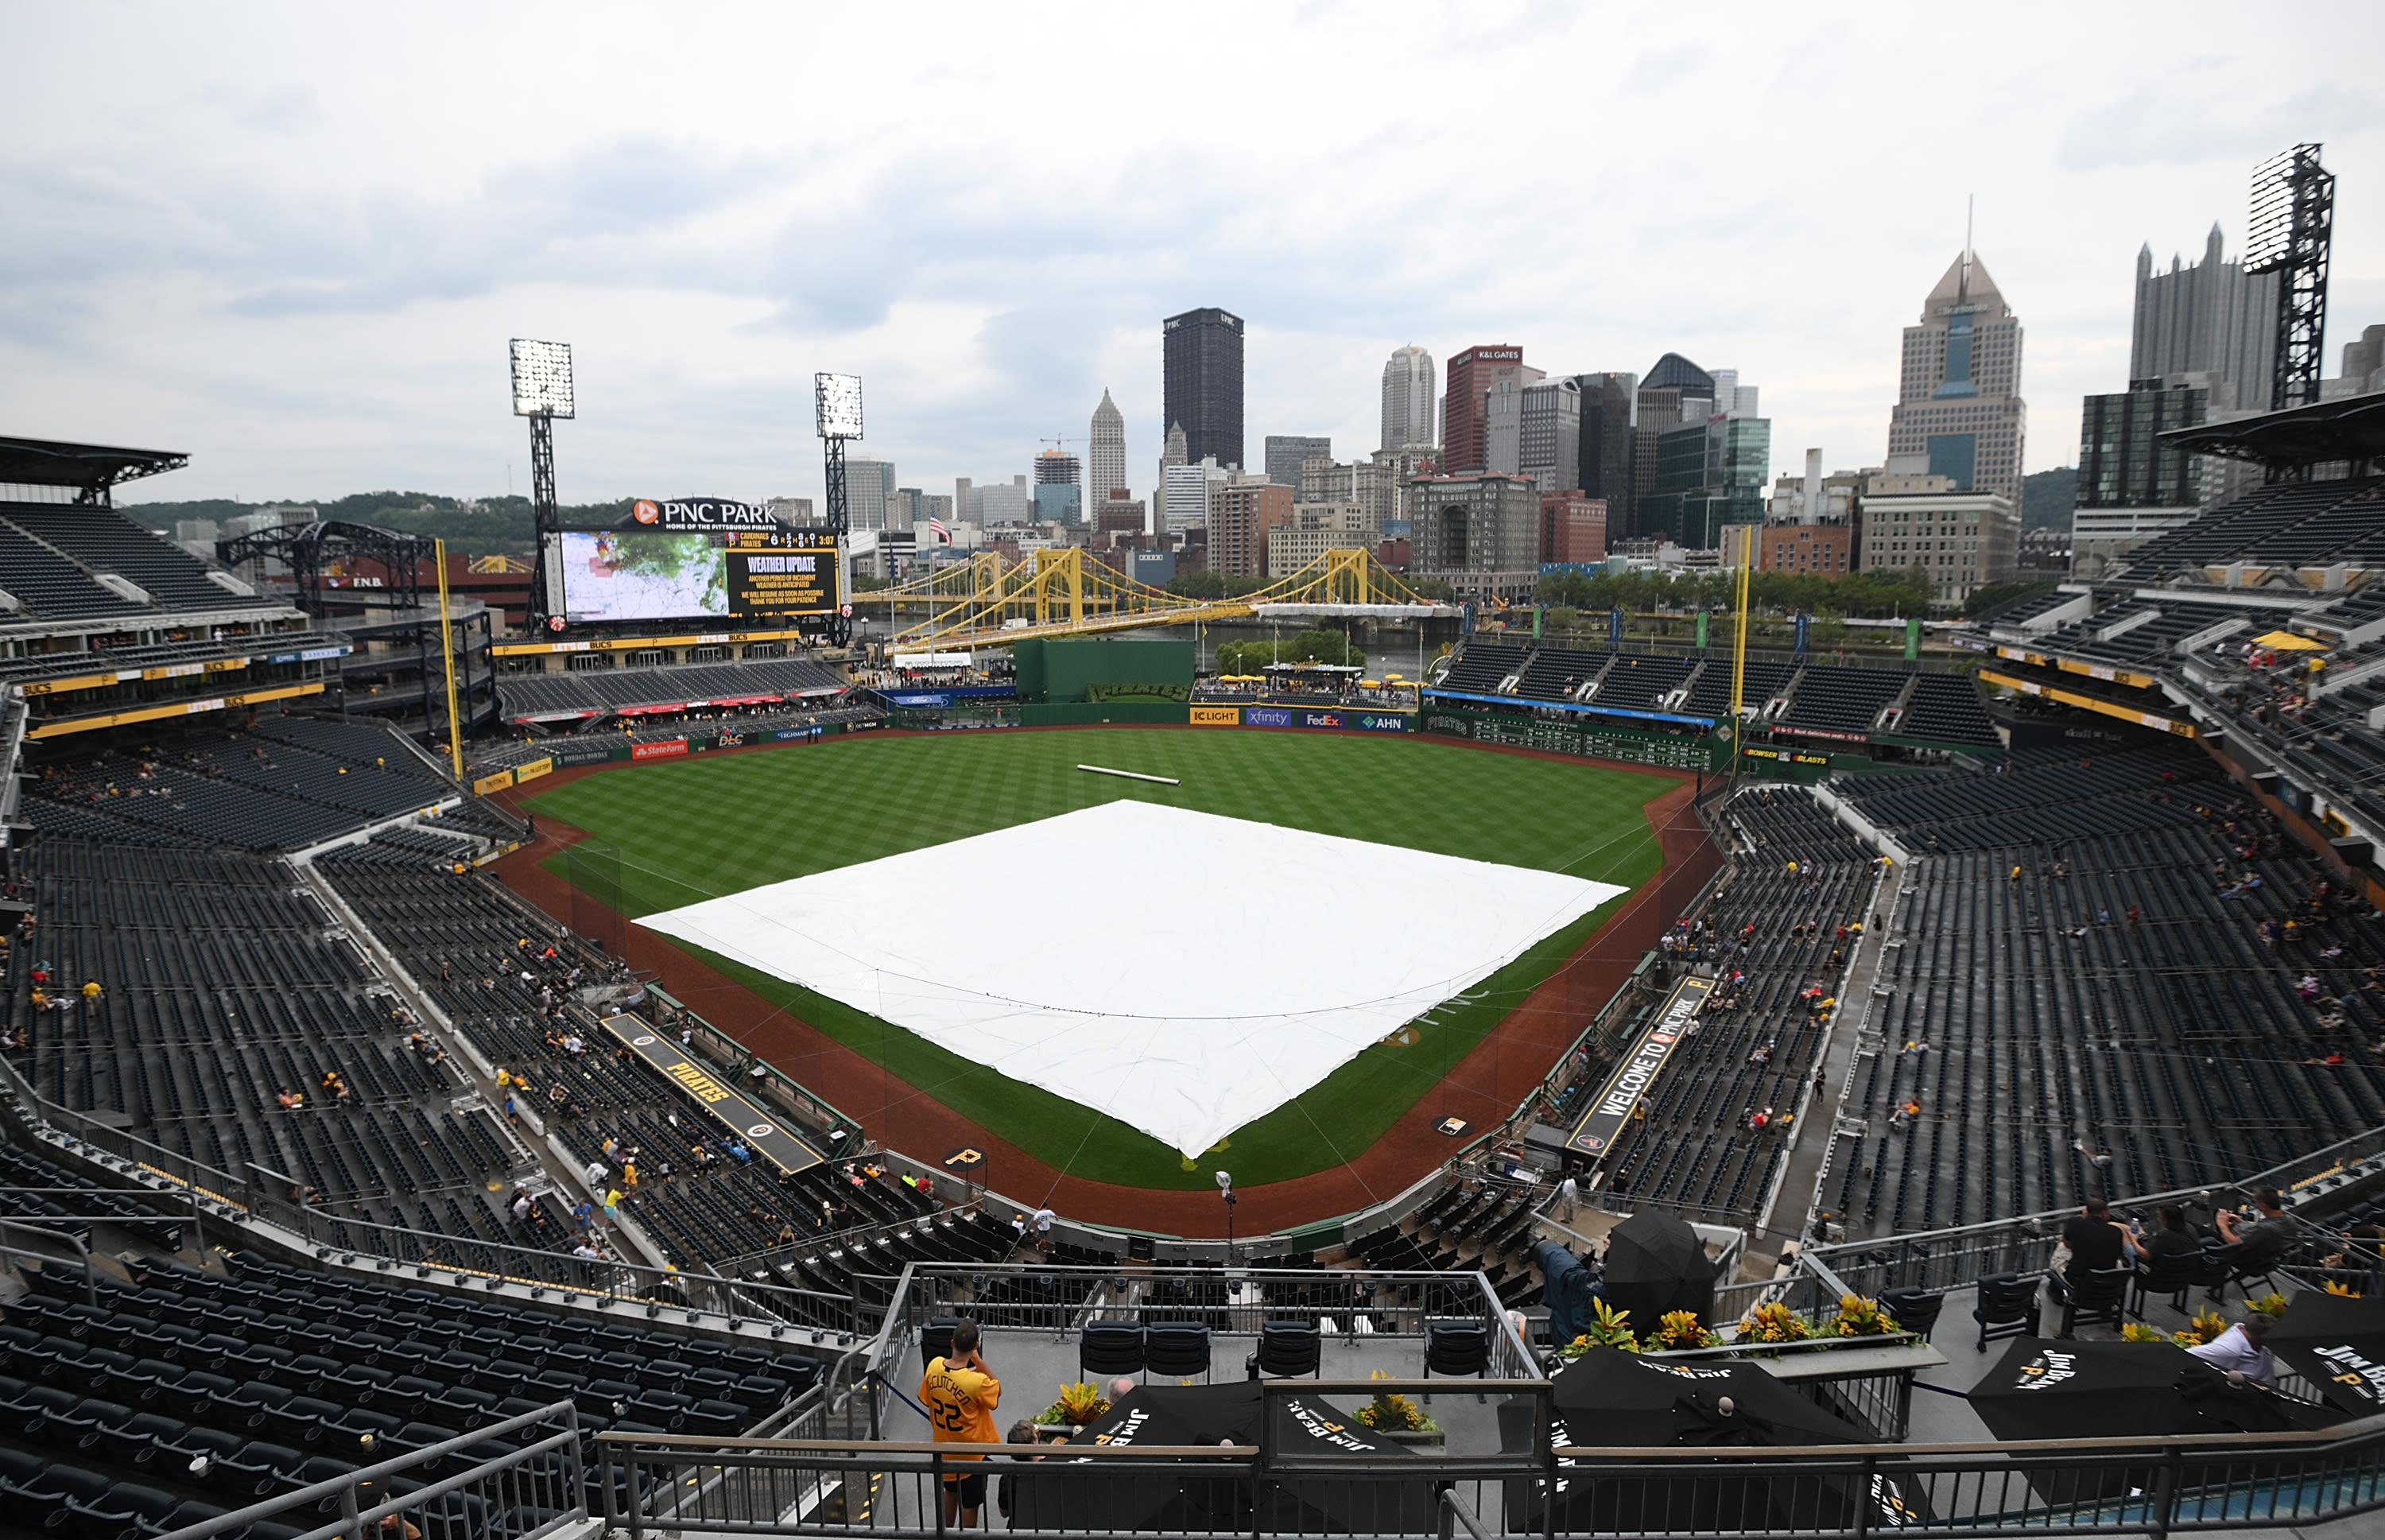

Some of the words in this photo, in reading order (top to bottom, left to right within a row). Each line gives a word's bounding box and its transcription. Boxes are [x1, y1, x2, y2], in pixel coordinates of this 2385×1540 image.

[662, 502, 715, 523] PNC
[719, 504, 778, 524] PARK
[770, 536, 778, 545] 6
[819, 535, 835, 545] 3:07
[747, 557, 785, 572] WEATHER
[786, 557, 816, 572] UPDATE
[590, 641, 612, 650] BUCS
[204, 661, 225, 671] BUCS
[1290, 660, 1323, 673] Miller
[23, 683, 52, 696] BUCS
[224, 696, 244, 707] BUCS
[1194, 712, 1205, 720] IC
[1251, 710, 1287, 725] xfinity
[1307, 715, 1339, 726] FedEx
[1377, 718, 1402, 729] AHN
[1427, 716, 1468, 735] PIRATES
[718, 733, 743, 747] DLC
[648, 746, 665, 754] State
[666, 743, 684, 754] Farm
[1747, 748, 1778, 758] BOWSER
[1797, 755, 1827, 765] BLASTS
[1688, 979, 1708, 989] P
[1599, 1057, 1657, 1116] WELCOME
[1640, 1042, 1666, 1062] TO
[1658, 1011, 1680, 1036] PNC
[1672, 999, 1697, 1019] PARK
[666, 1061, 730, 1104] PIRATES
[945, 1148, 982, 1165] P
[2042, 1349, 2077, 1371] JIM
[2312, 1344, 2375, 1369] JIM
[1635, 1359, 1697, 1380] BEAM
[1700, 1367, 1732, 1379] JIM
[2013, 1369, 2077, 1391] BEAM
[932, 1396, 964, 1432] 22
[1120, 1407, 1150, 1436] JIM
[1286, 1398, 1332, 1438] BEAM
[1326, 1434, 1376, 1452] JIM
